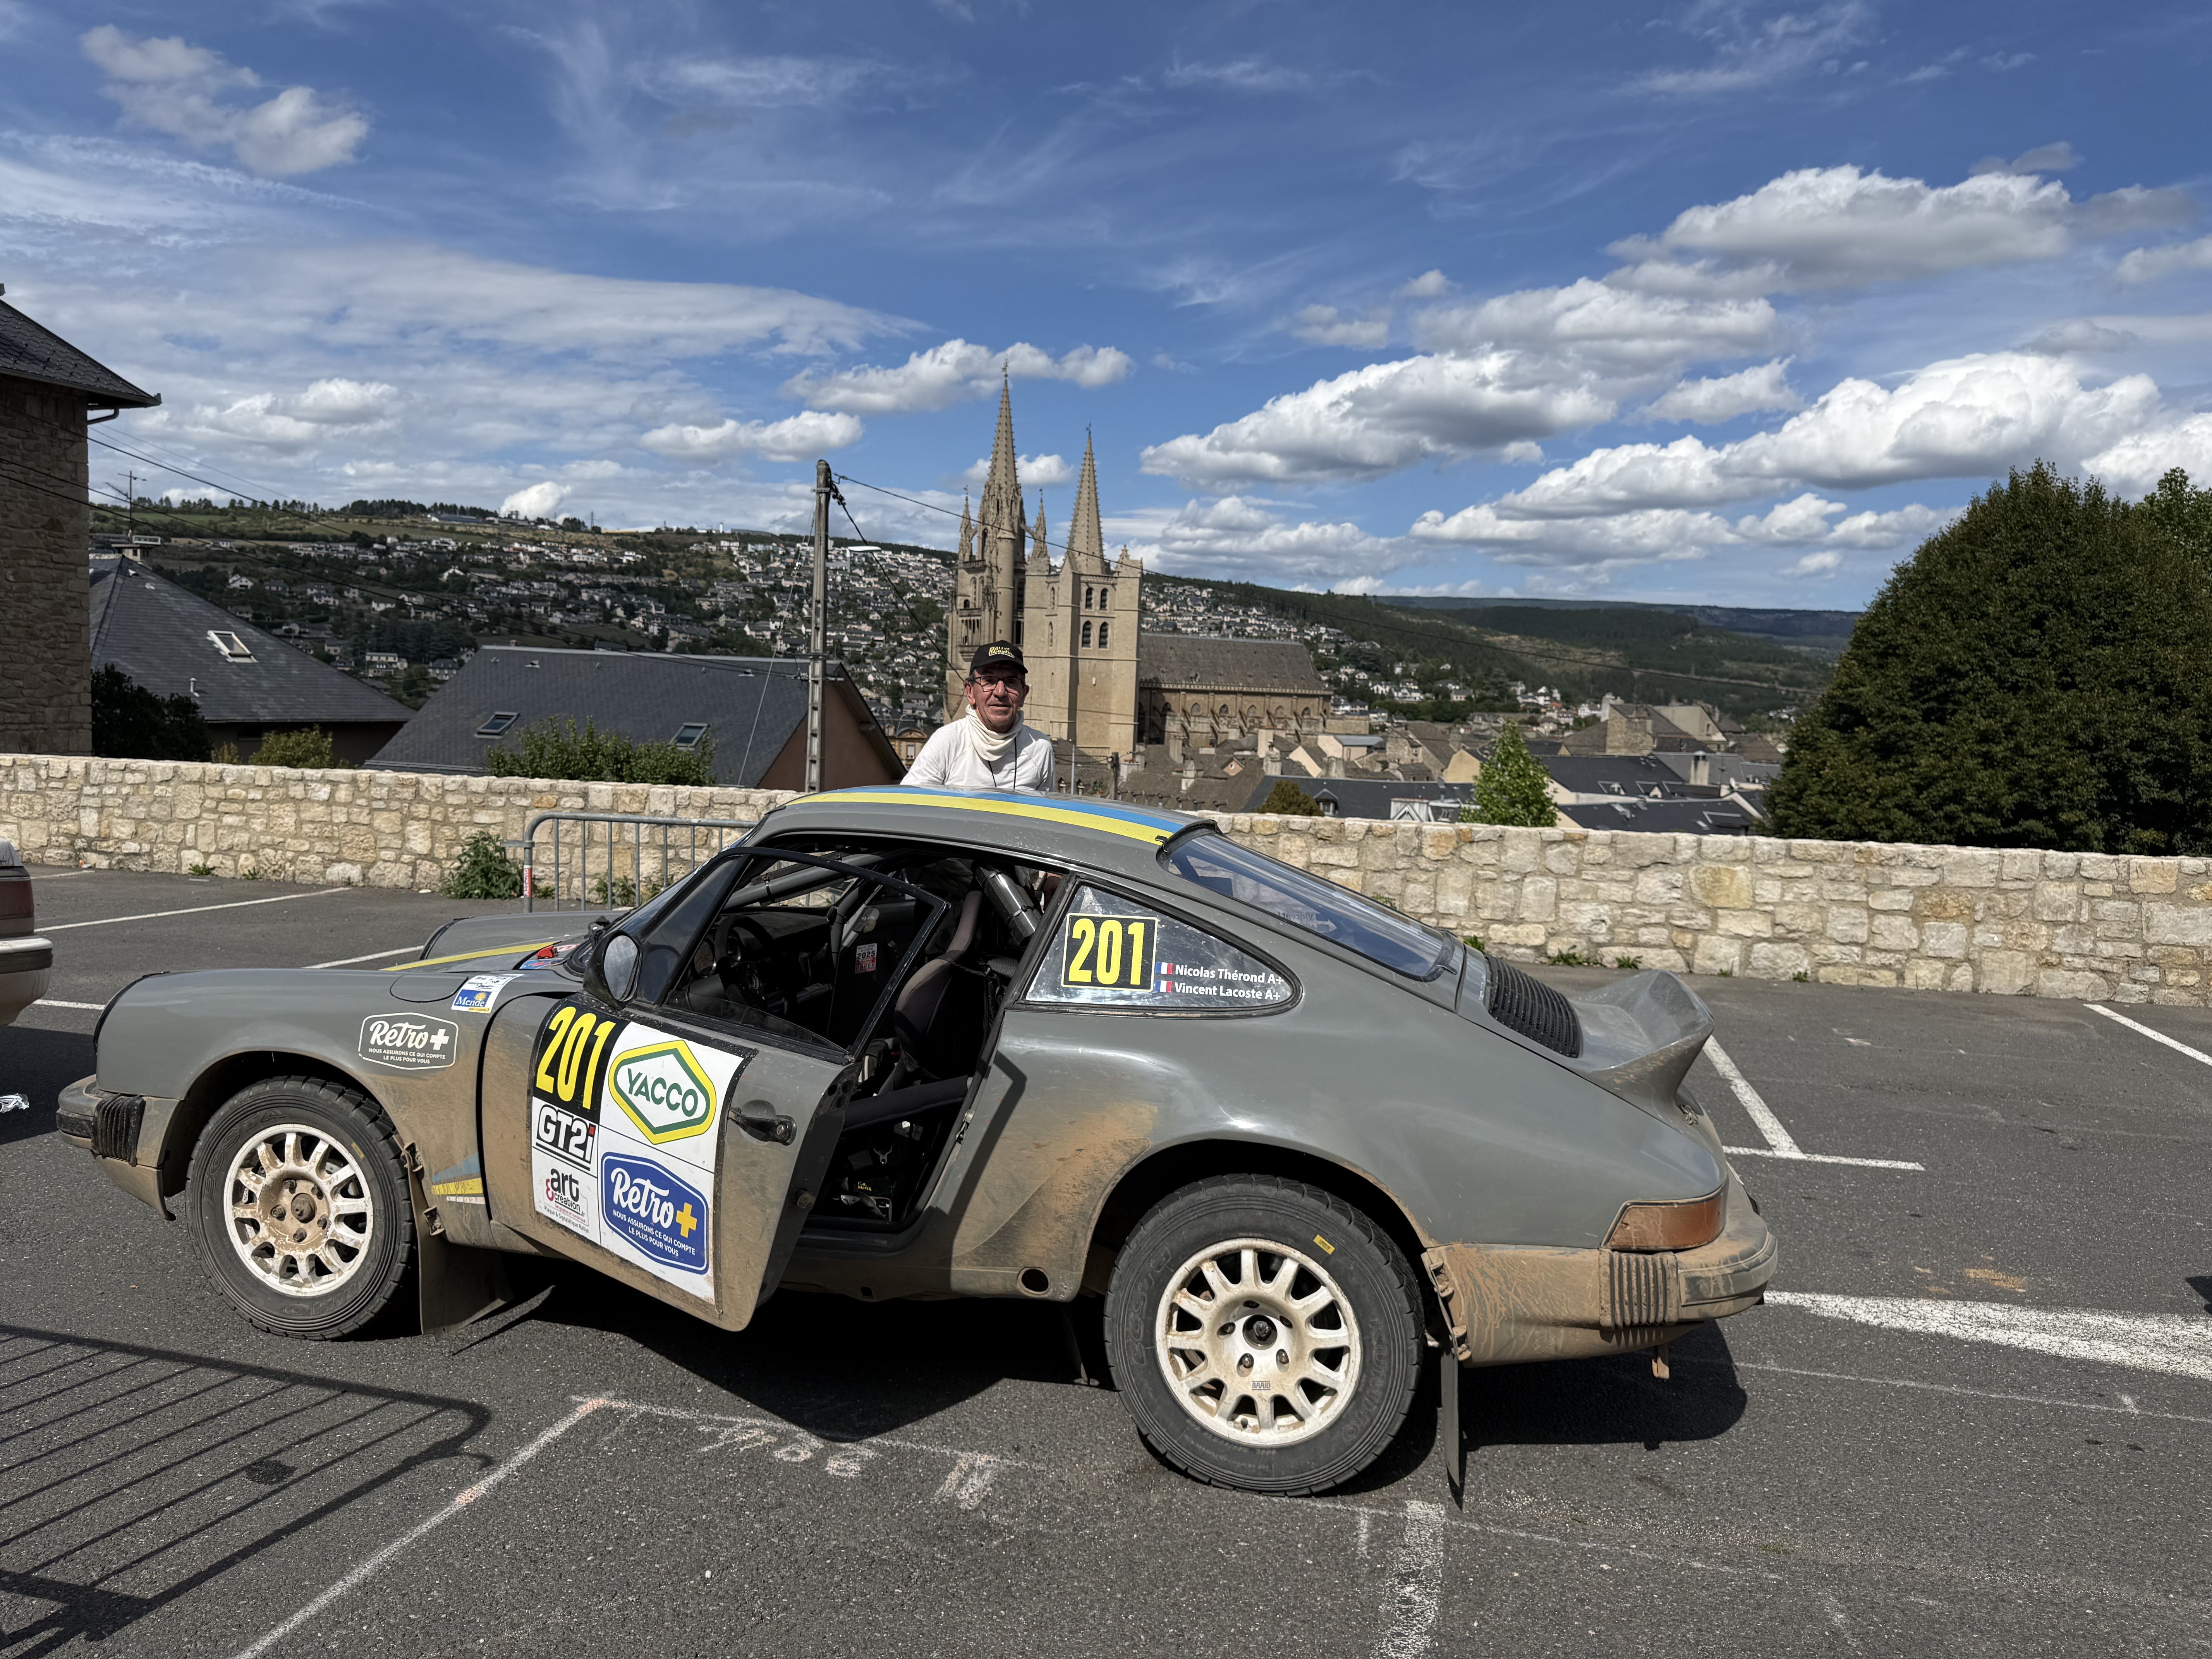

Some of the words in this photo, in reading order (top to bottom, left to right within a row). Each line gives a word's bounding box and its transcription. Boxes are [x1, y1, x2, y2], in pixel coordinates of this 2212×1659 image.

[857, 950, 875, 959] 2025
[1068, 918, 1145, 985] 201
[1175, 964, 1215, 978] Nicolas
[1218, 969, 1265, 983] Thérond
[1267, 974, 1284, 985] A+
[456, 996, 484, 1007] Mende
[1175, 982, 1217, 995] Vincent
[1219, 986, 1262, 999] Lacoste
[1264, 989, 1281, 1000] A+
[536, 1006, 616, 1109] 201
[627, 1068, 697, 1117] YACCO
[203, 1109, 286, 1202] ECSTA
[551, 1168, 579, 1202] art
[555, 1193, 580, 1212] création
[613, 1209, 627, 1221] NOUS
[627, 1217, 654, 1235] ASSURONS
[655, 1230, 662, 1239] CE
[663, 1234, 672, 1244] QUI
[673, 1239, 696, 1255] COMPTE
[629, 1226, 635, 1235] LE
[636, 1230, 648, 1242] PLUS
[649, 1236, 663, 1249] POUR
[664, 1244, 679, 1257] VOUS
